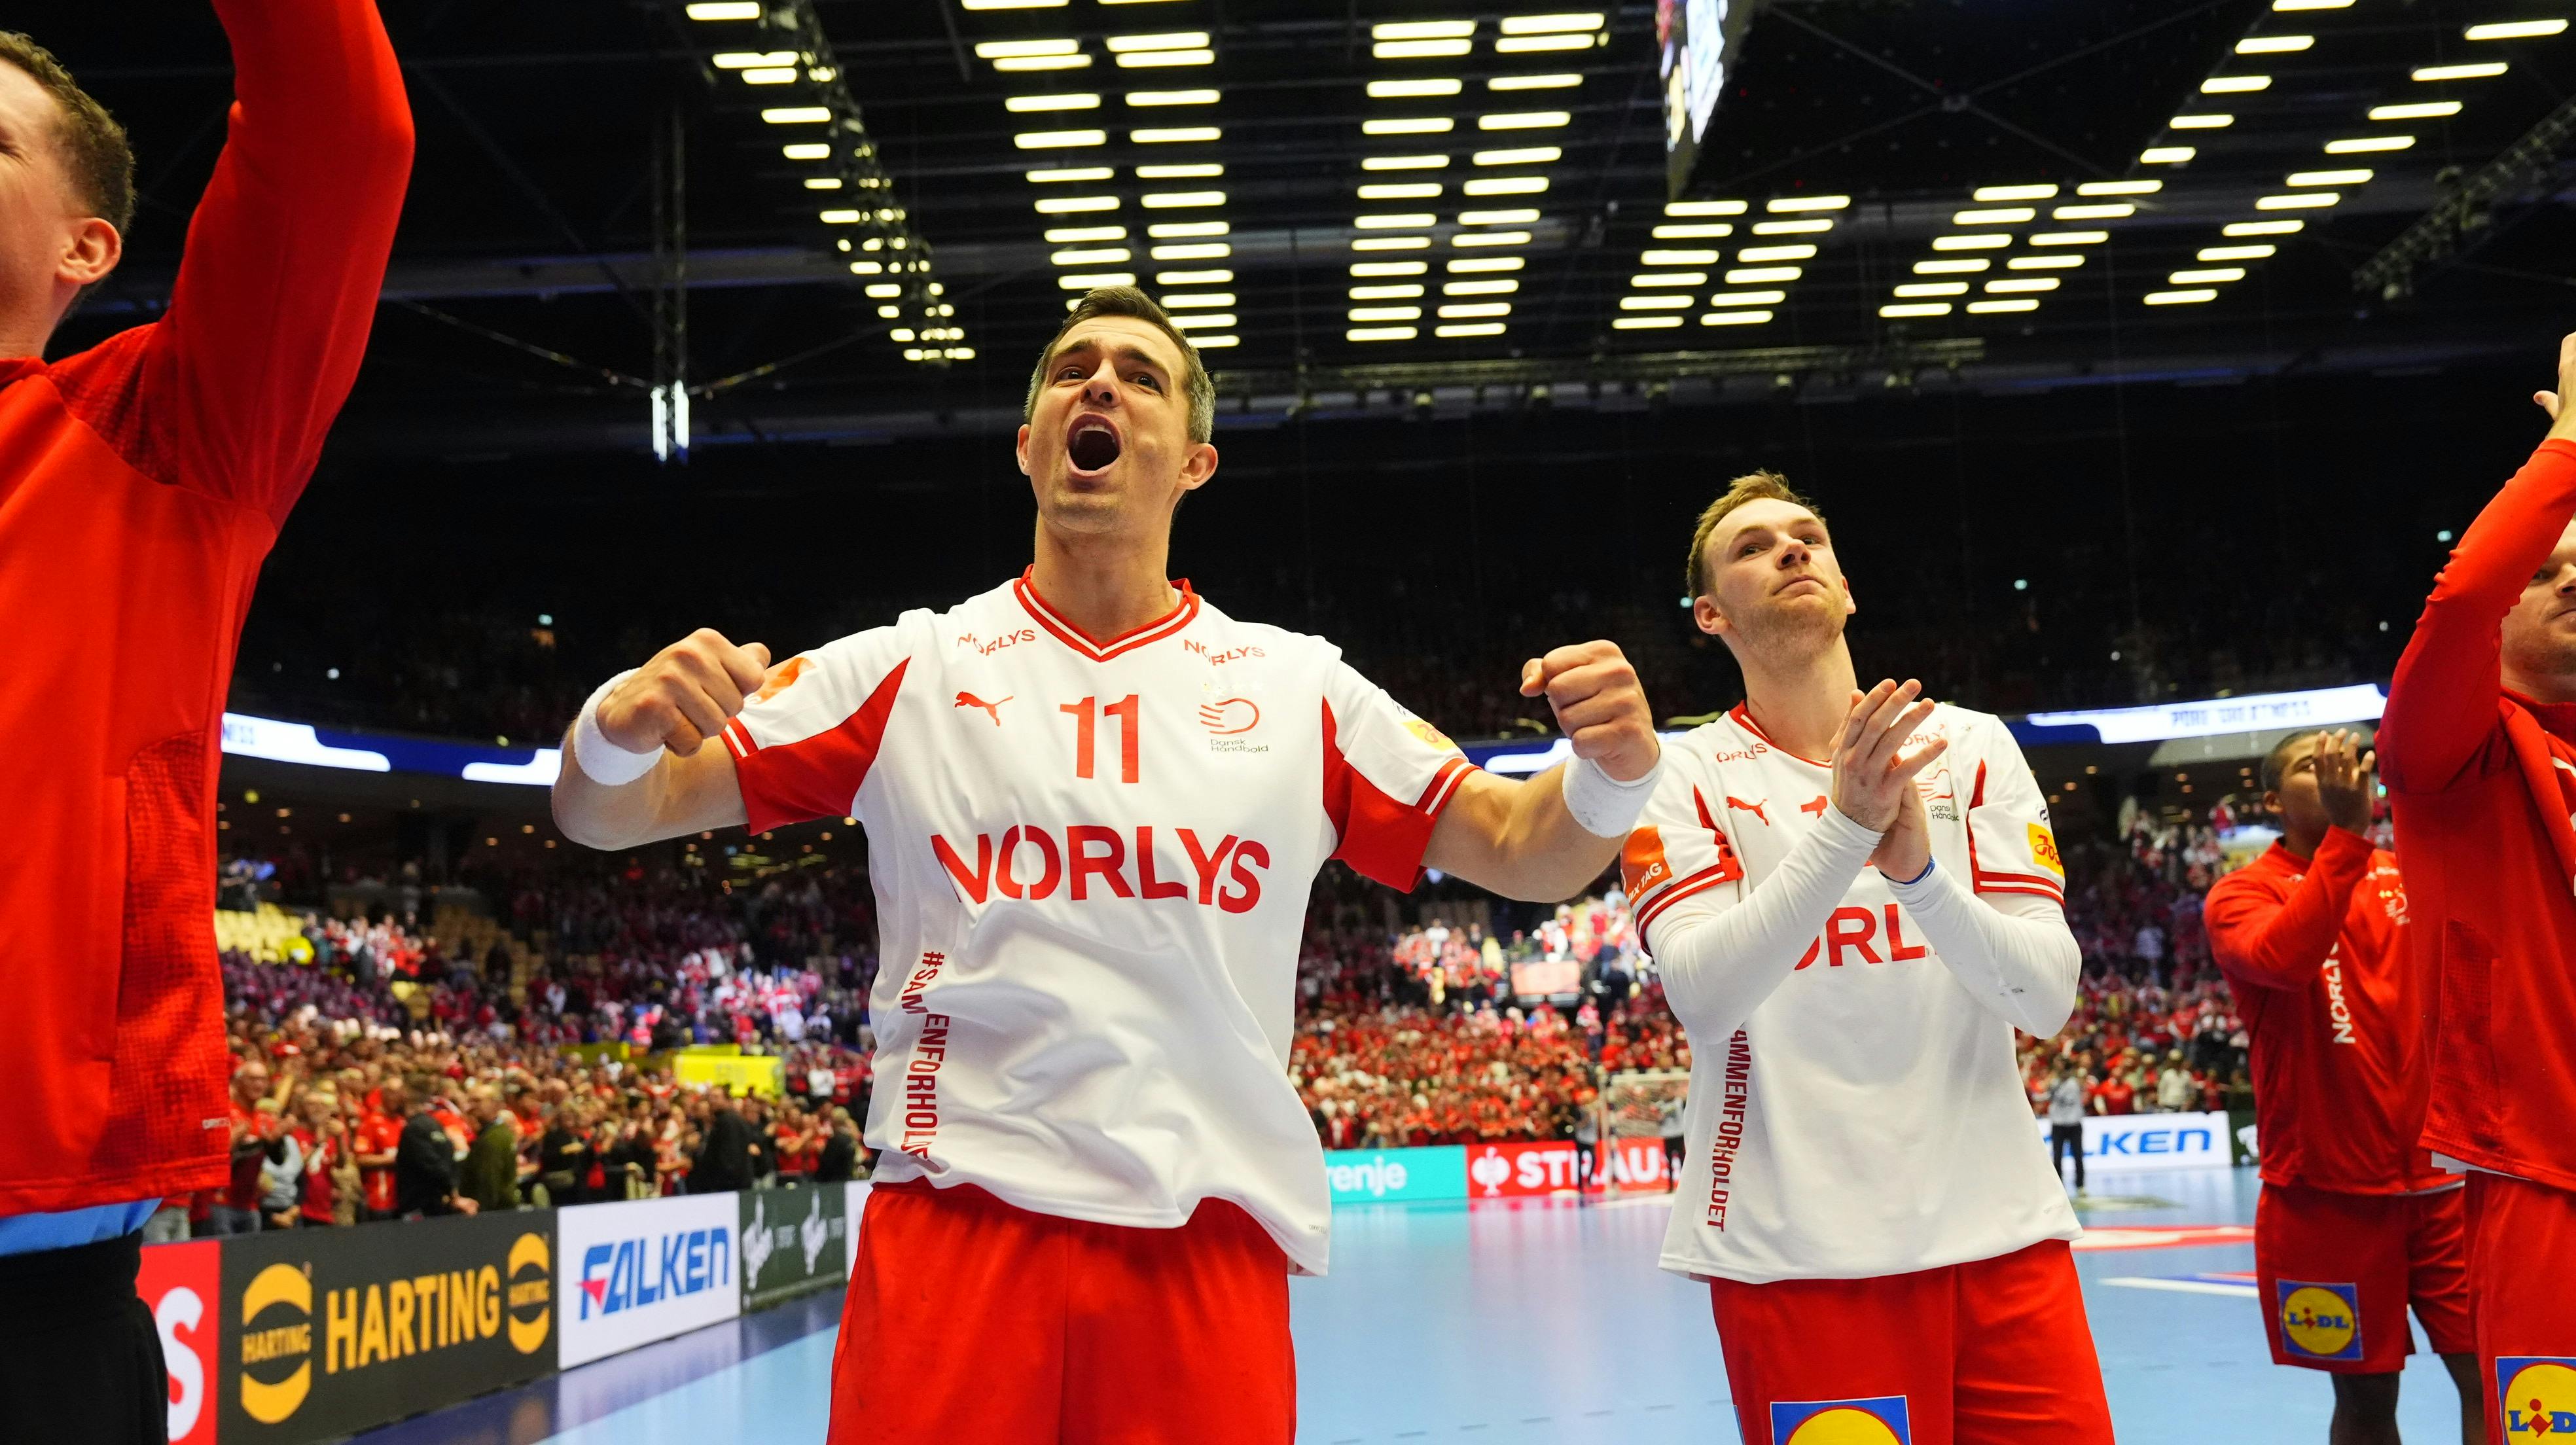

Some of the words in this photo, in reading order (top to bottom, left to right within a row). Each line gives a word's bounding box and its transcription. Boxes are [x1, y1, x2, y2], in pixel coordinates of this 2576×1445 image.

[1184, 639, 1265, 666] NORLYS
[1060, 694, 1139, 783] 11
[1717, 743, 1767, 763] ORLYS
[1930, 805, 1950, 813] Dans
[931, 824, 1271, 914] NORLYS
[1641, 862, 1663, 888] TAG
[1707, 1029, 1751, 1230] AMMENFORHOLDET
[579, 1226, 731, 1322] FALKEN
[241, 1323, 312, 1365] HARTING
[326, 1264, 501, 1374] HARTING
